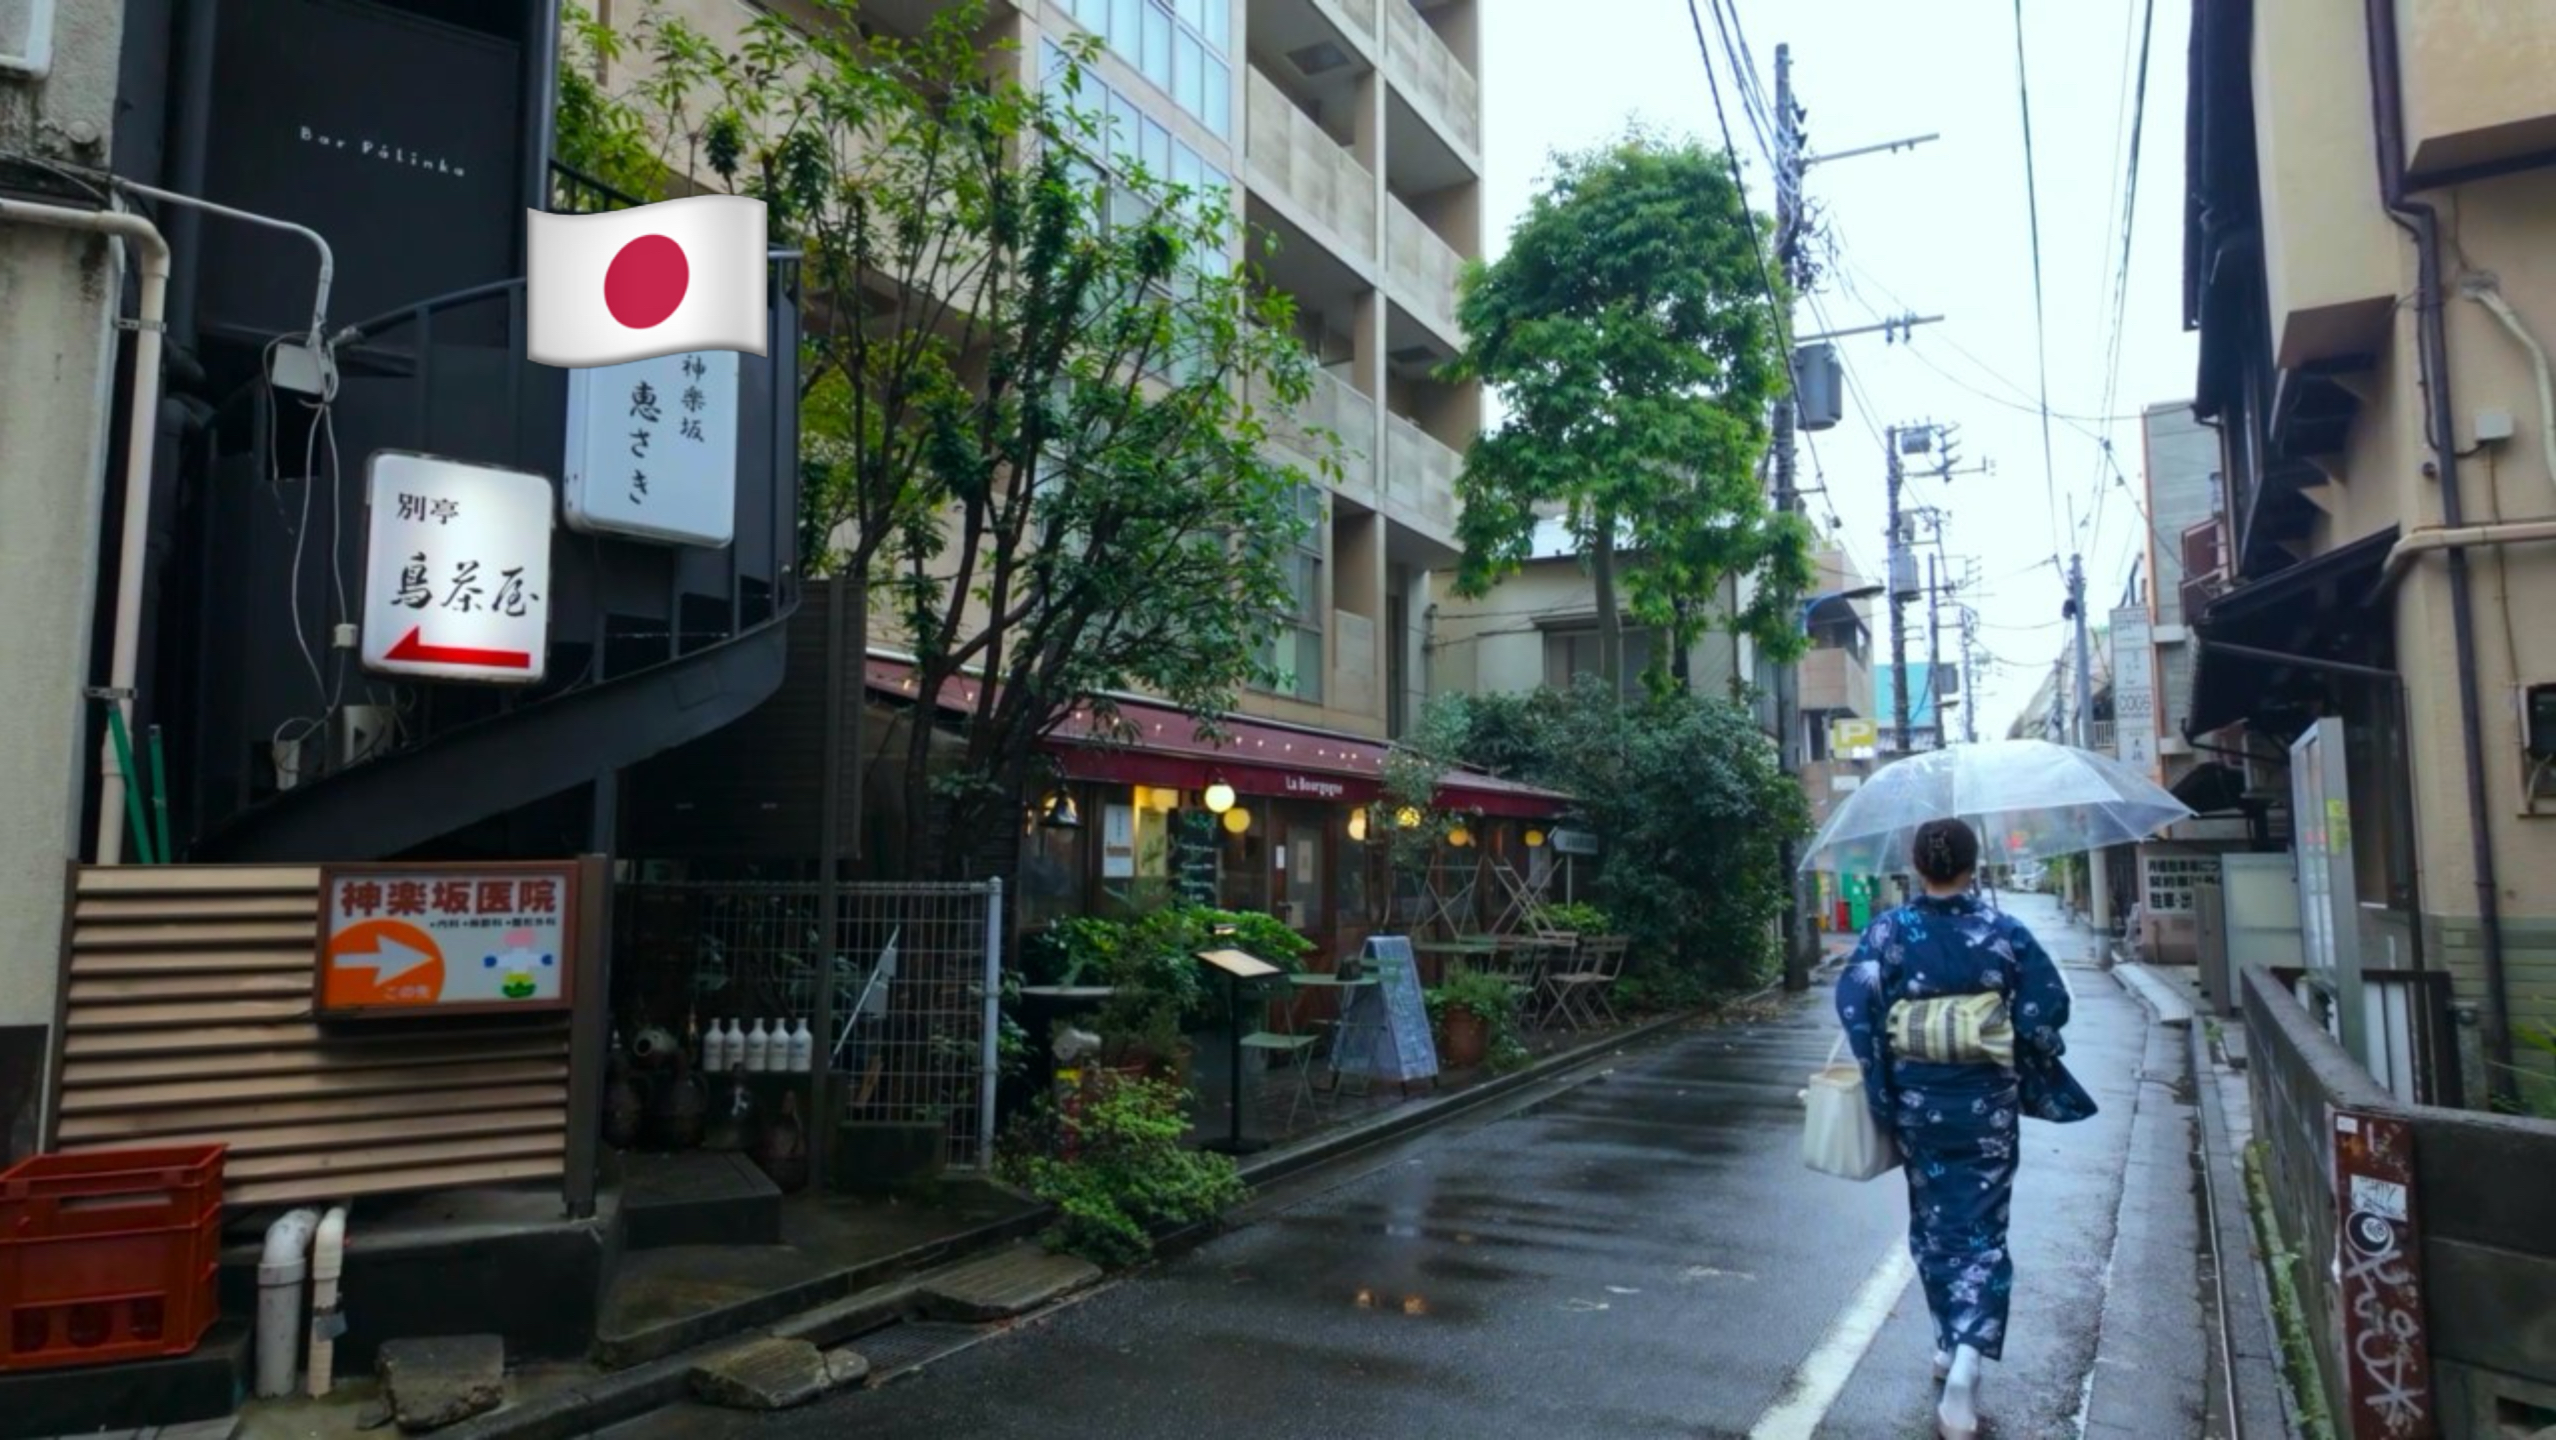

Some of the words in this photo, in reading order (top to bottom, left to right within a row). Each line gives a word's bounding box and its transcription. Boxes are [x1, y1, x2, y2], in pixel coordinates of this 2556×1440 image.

[301, 126, 345, 149] Bar
[680, 354, 707, 442] 神楽坂
[629, 380, 662, 505] 恵さき
[397, 493, 459, 525] 別亭
[390, 551, 540, 617] 鳥茶屋
[1841, 722, 1871, 744] P
[1285, 775, 1297, 791] La
[341, 880, 557, 917] 神楽坂医院
